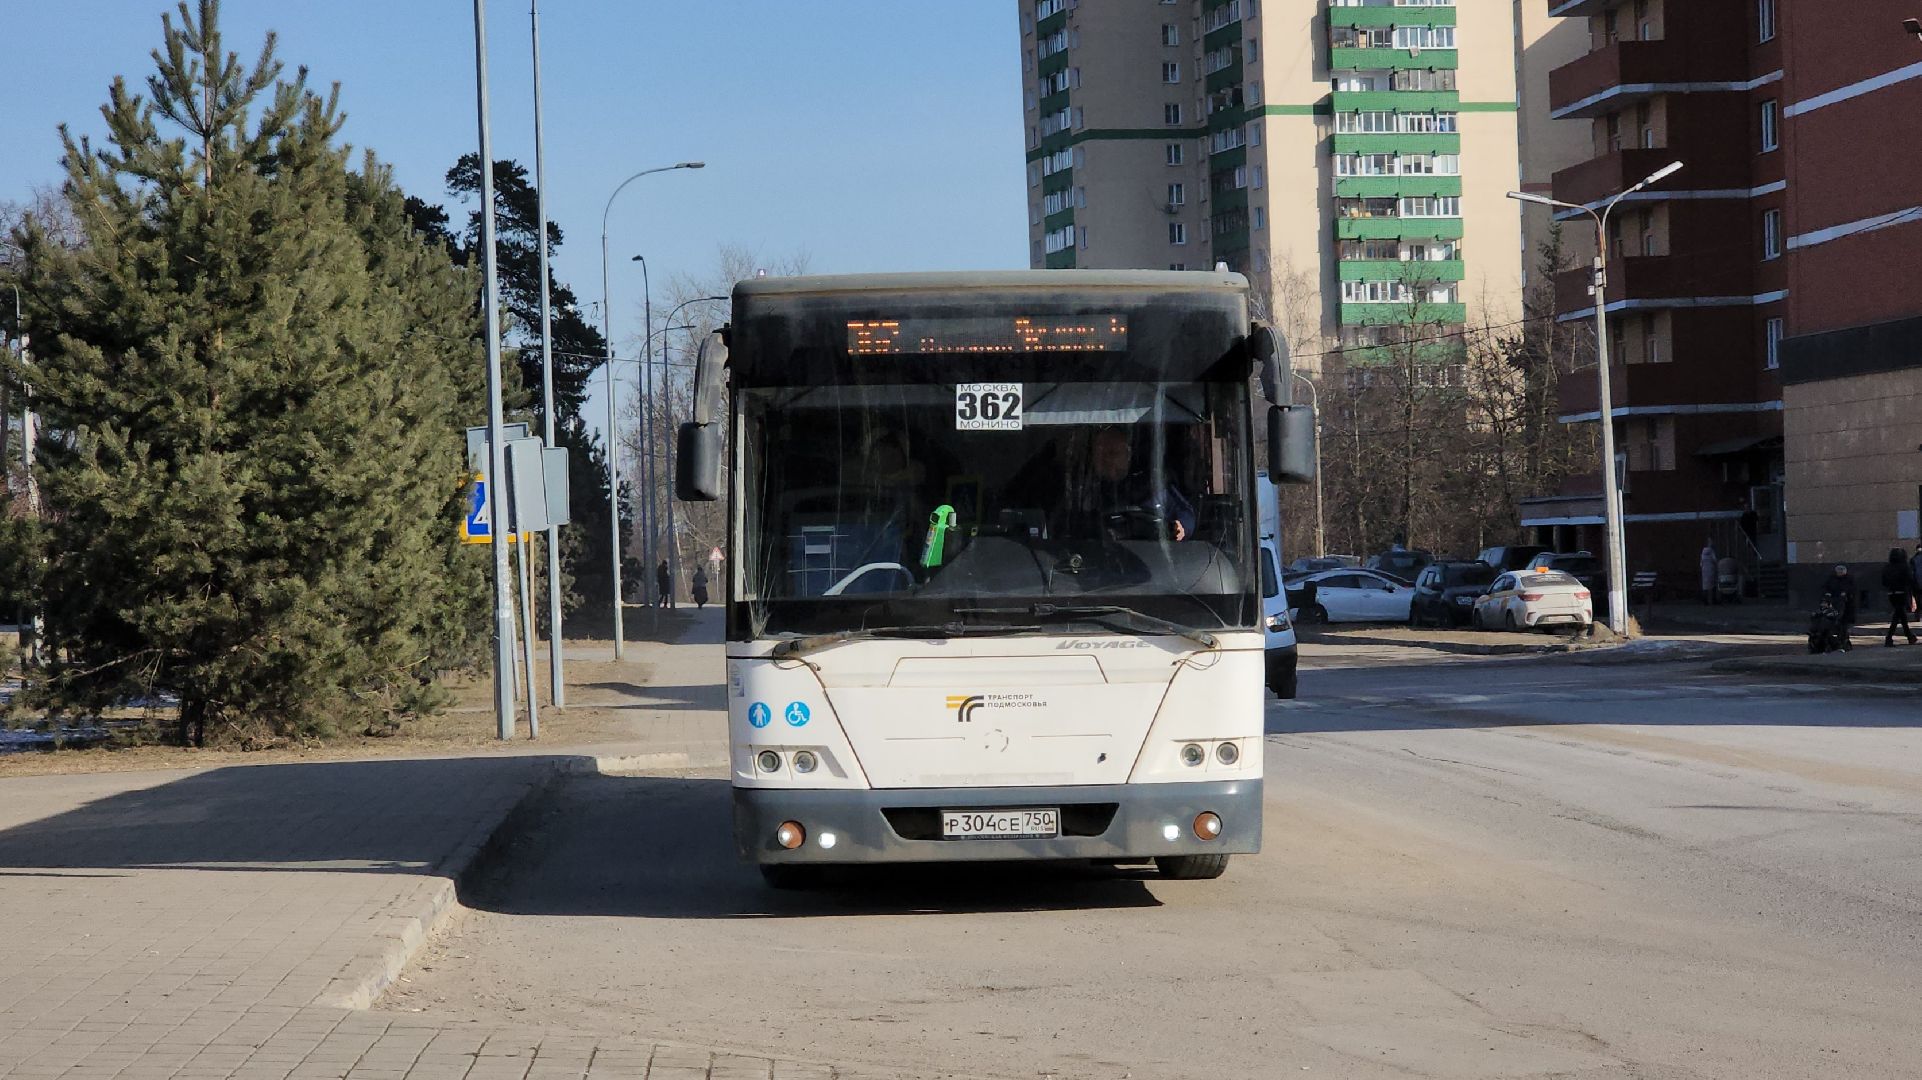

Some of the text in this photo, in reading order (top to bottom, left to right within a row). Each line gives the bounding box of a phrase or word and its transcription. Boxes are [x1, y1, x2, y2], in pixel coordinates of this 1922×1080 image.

[958, 392, 1020, 420] 362
[960, 420, 1020, 428] МОНИНО
[1024, 813, 1051, 826] 750
